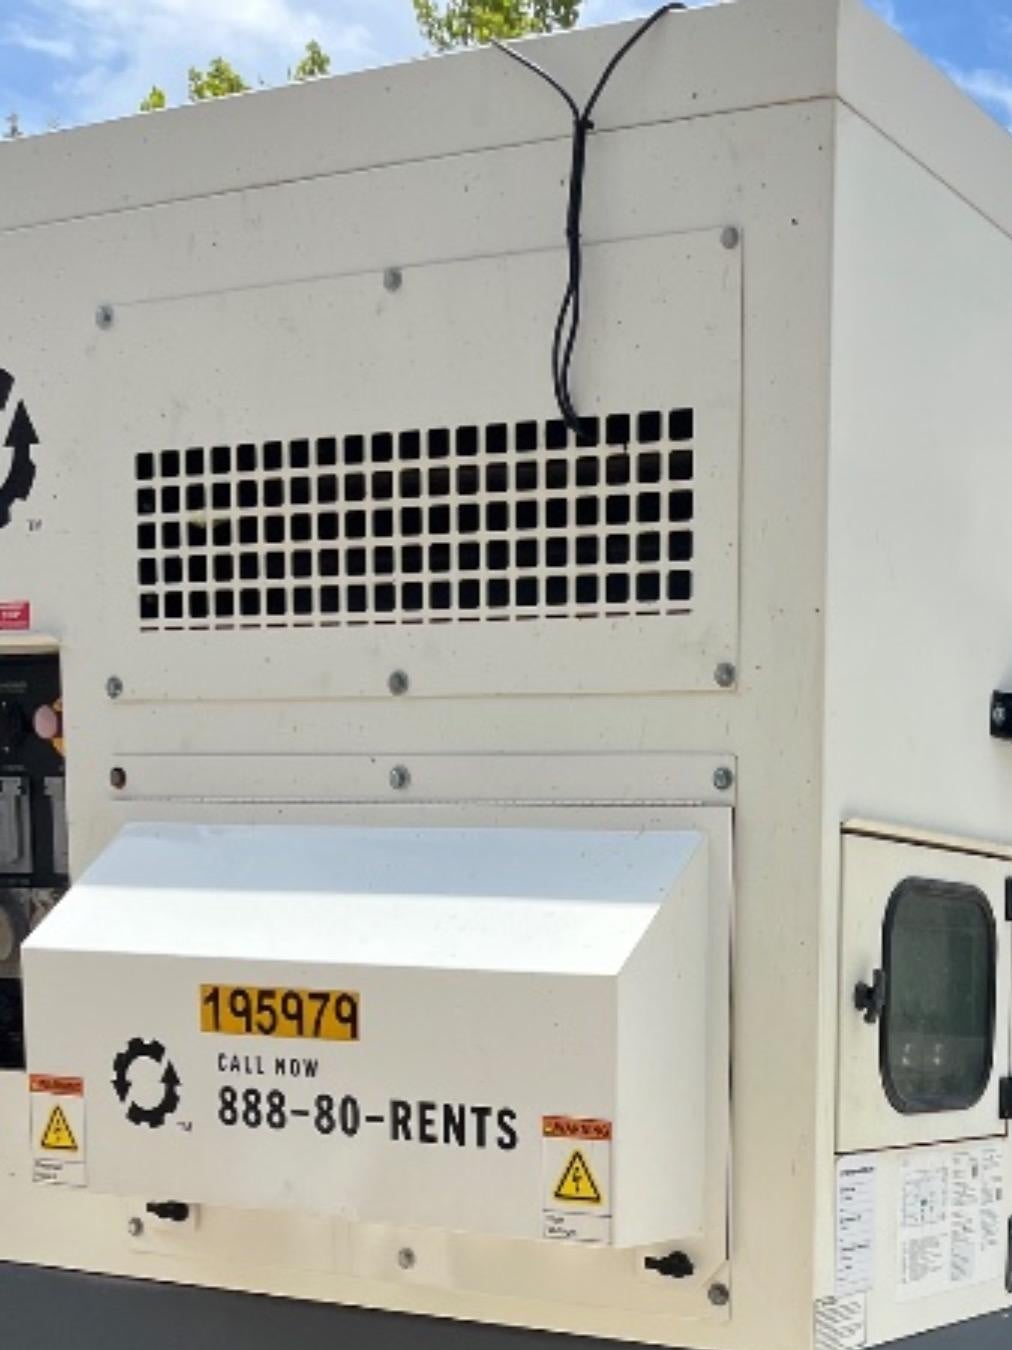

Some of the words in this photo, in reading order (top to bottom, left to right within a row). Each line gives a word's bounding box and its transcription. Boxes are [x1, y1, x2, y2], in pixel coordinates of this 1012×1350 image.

[202, 986, 359, 1040] 195979
[218, 1052, 264, 1076] CALL
[274, 1057, 319, 1079] NOW
[218, 1085, 519, 1150] 888-80-RENTS
